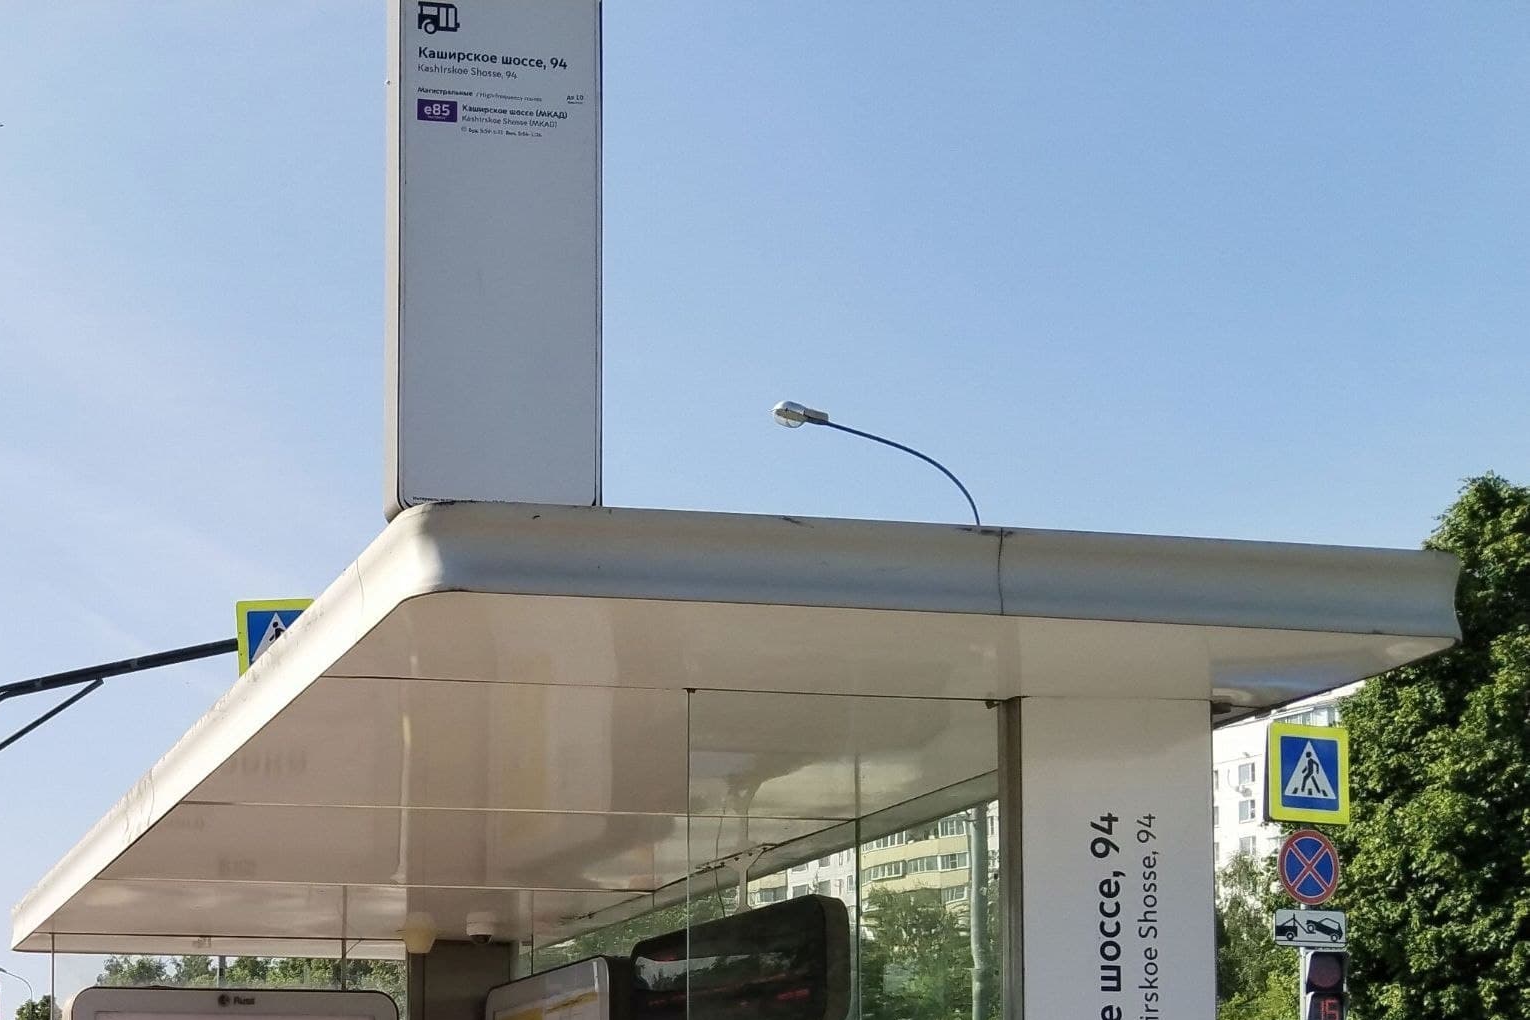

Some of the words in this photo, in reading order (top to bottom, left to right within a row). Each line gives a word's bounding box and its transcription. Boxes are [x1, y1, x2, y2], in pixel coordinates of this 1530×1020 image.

[418, 46, 497, 64] Каширское
[501, 54, 547, 70] шоссе,
[550, 57, 568, 69] 94
[417, 63, 469, 75] Kashirskoe
[505, 71, 518, 79] 94
[424, 103, 451, 116] e85
[461, 115, 501, 124] Kashirskoe
[529, 119, 558, 128] (MKAD)
[462, 104, 508, 115] Каширское
[509, 109, 534, 117] шоссе
[535, 109, 568, 119] (МКАД)
[1090, 812, 1120, 859] 94
[1136, 812, 1157, 844] 94
[1137, 849, 1159, 940] Shosse,
[1097, 869, 1127, 992] шоссе,
